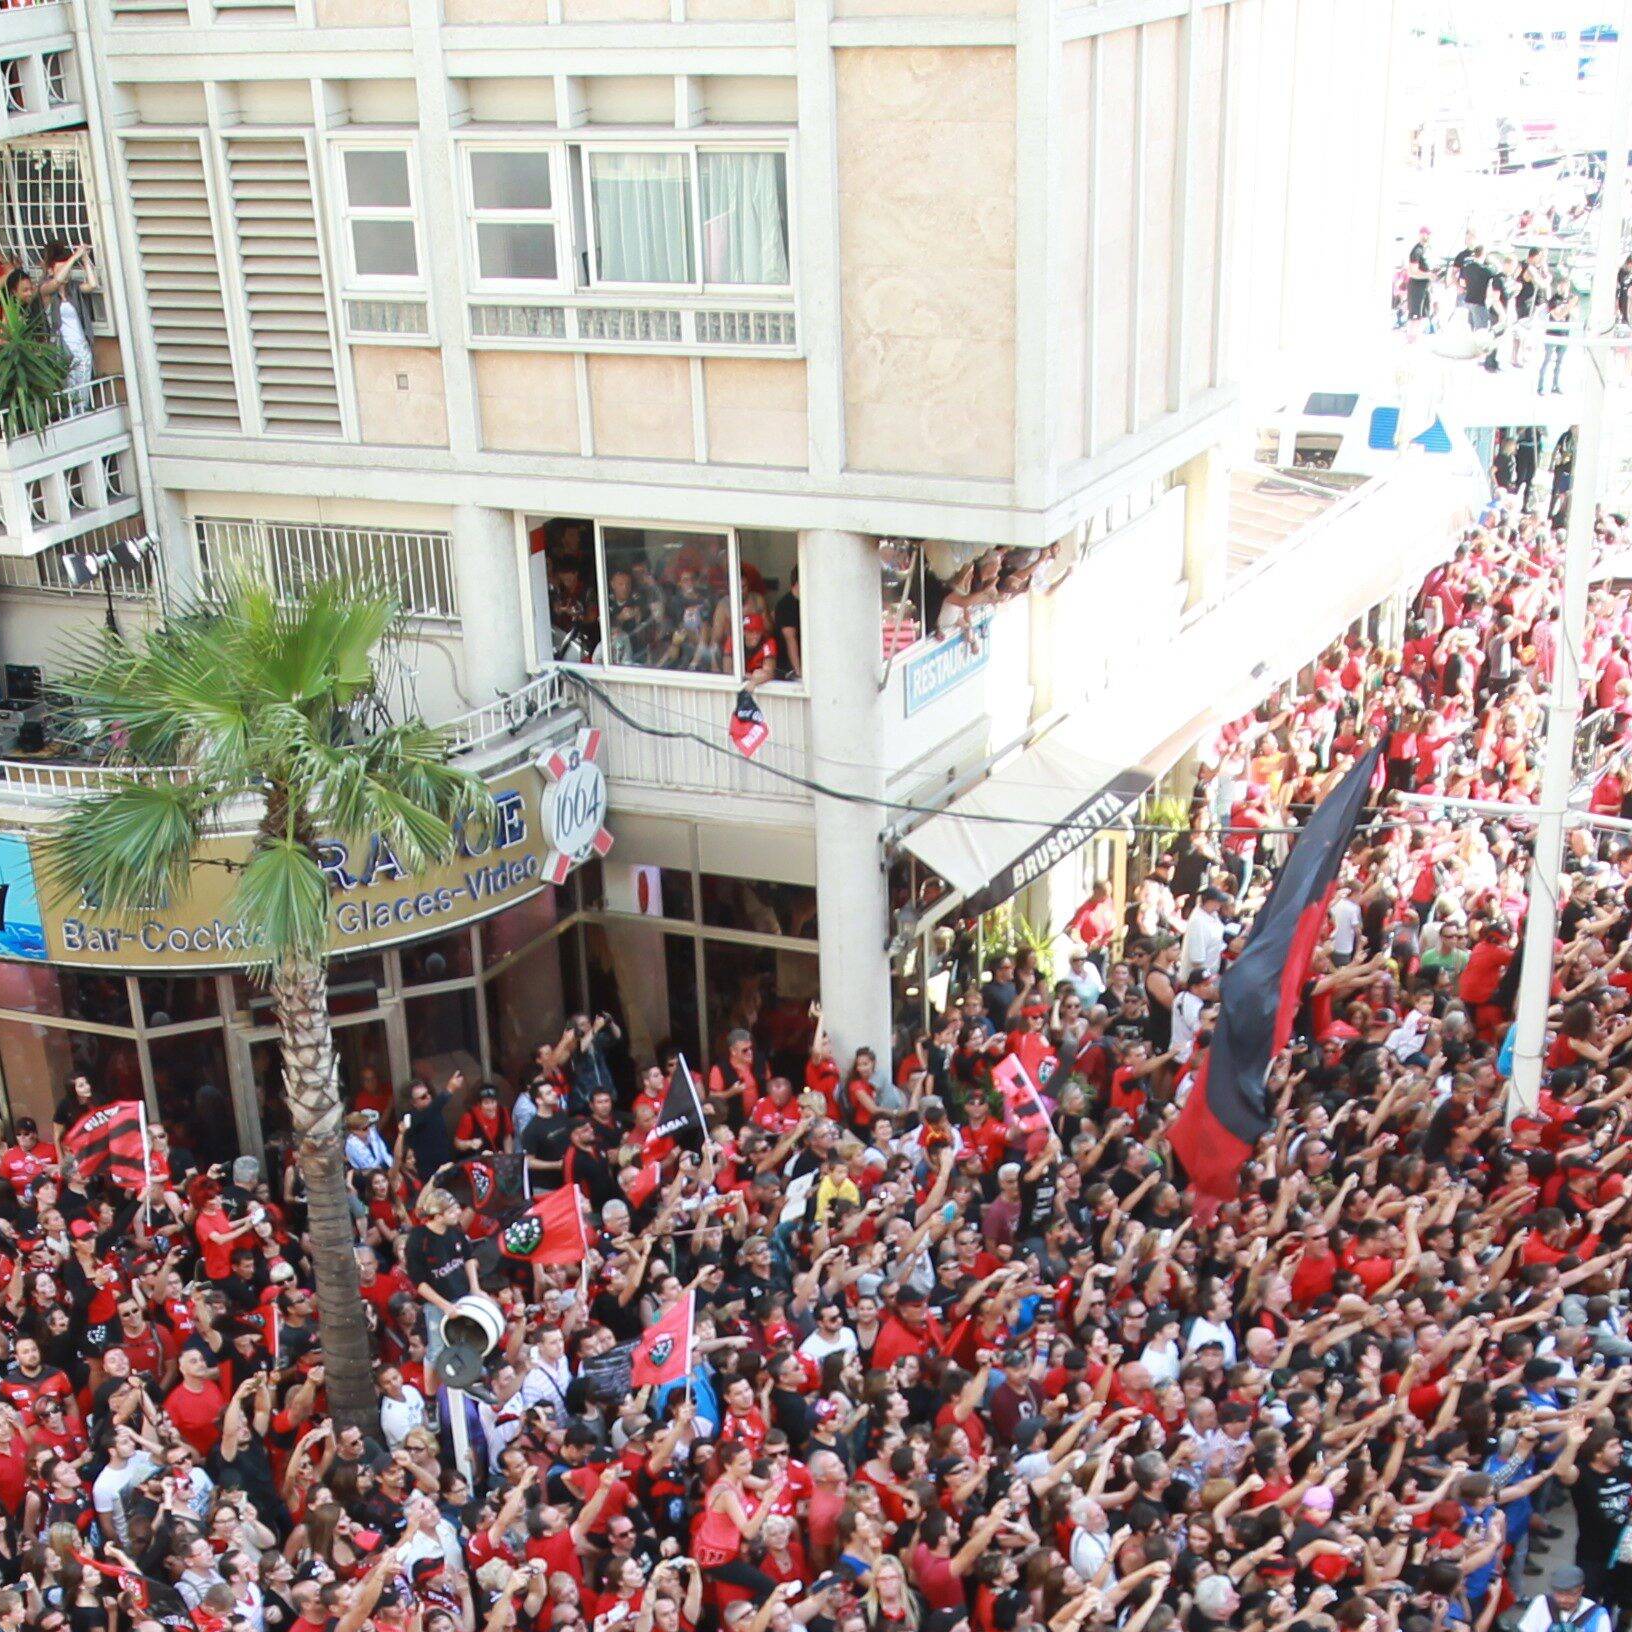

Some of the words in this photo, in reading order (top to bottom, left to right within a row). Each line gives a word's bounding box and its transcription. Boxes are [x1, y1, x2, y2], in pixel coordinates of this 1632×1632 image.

[555, 769, 601, 839] 1664
[1012, 790, 1126, 889] BRUSCHETTA
[336, 853, 541, 937] Glaces-Video
